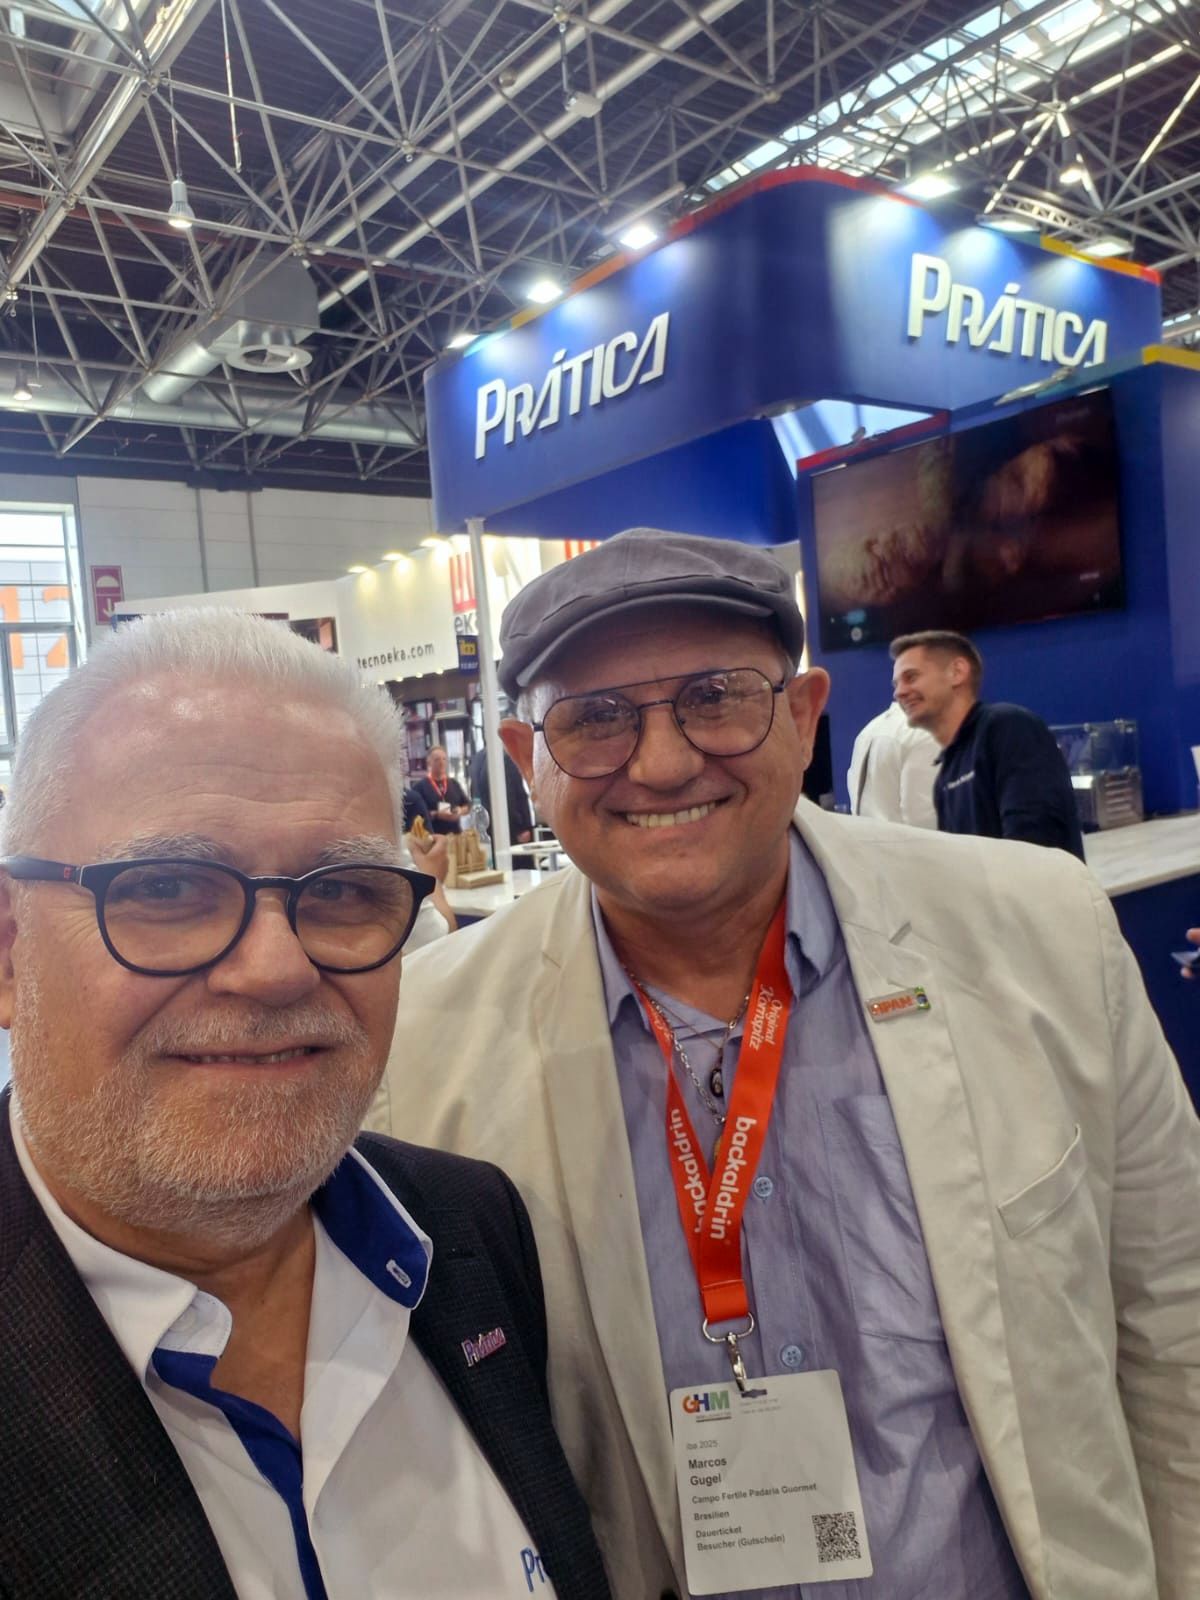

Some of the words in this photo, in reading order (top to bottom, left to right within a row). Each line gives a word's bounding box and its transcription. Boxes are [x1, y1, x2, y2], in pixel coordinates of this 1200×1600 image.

[356, 641, 435, 669] tecnoeka.com
[710, 1116, 757, 1240] backaldrin
[682, 1390, 731, 1414] GHM
[699, 1439, 718, 1449] 2025
[688, 1457, 728, 1470] Marcos
[690, 1473, 722, 1487] Gugel
[692, 1494, 720, 1505] Campo
[722, 1490, 747, 1501] Fertile
[749, 1487, 780, 1497] Padaria
[694, 1510, 730, 1521] Brasilien
[695, 1526, 742, 1538] Dauerticket
[697, 1539, 736, 1551] Besucher
[738, 1533, 785, 1548] (Gutschein)
